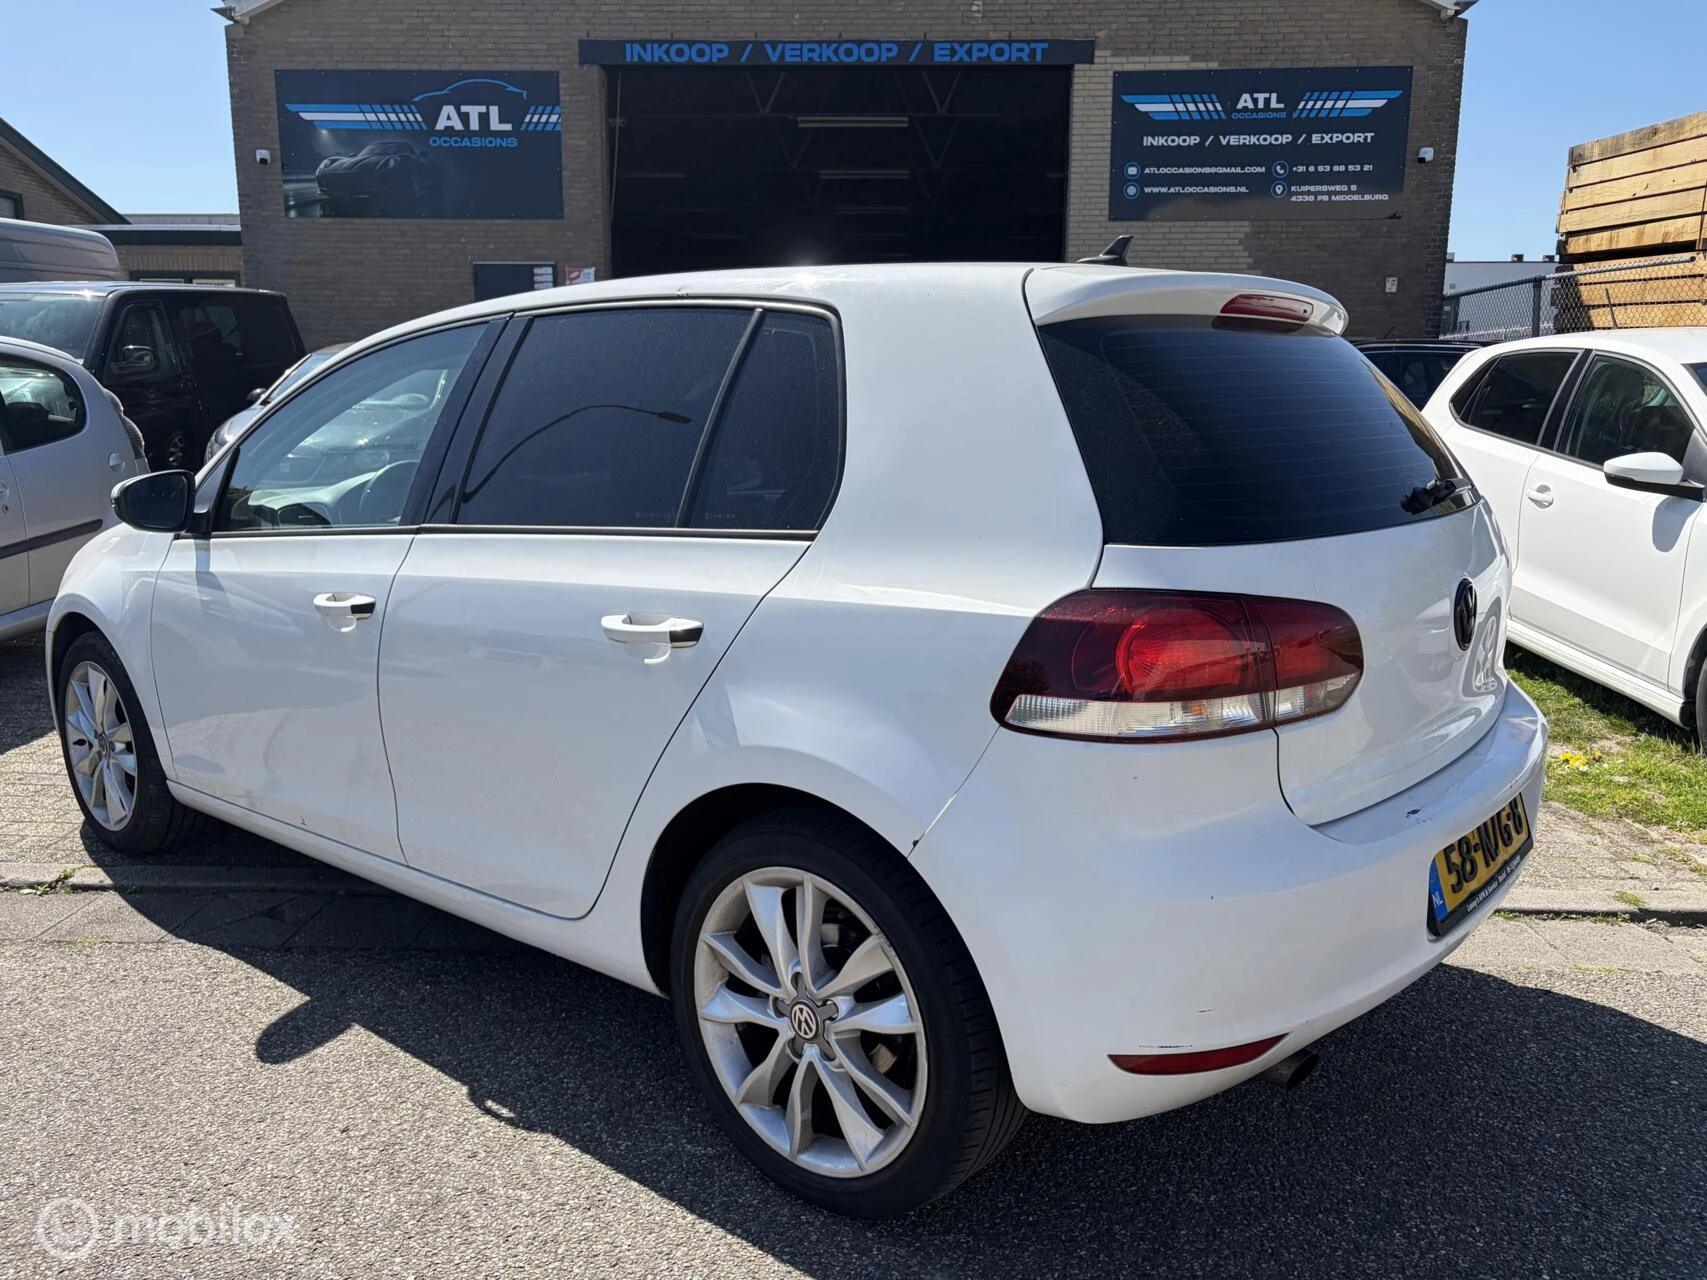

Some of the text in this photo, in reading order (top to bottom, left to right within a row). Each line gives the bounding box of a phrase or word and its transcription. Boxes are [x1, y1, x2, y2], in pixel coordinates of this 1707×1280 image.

[624, 42, 1048, 63] INKOOP / VERKOOP / EXPORT
[1236, 92, 1285, 109] ATL
[434, 105, 513, 131] ATL
[1231, 111, 1287, 119] OCCASIONS
[428, 136, 518, 148] OCCASIONS
[1143, 136, 1201, 147] INKOOP
[1219, 134, 1293, 146] VERKOOP
[1311, 132, 1375, 144] EXPORT
[1432, 892, 1443, 908] NL
